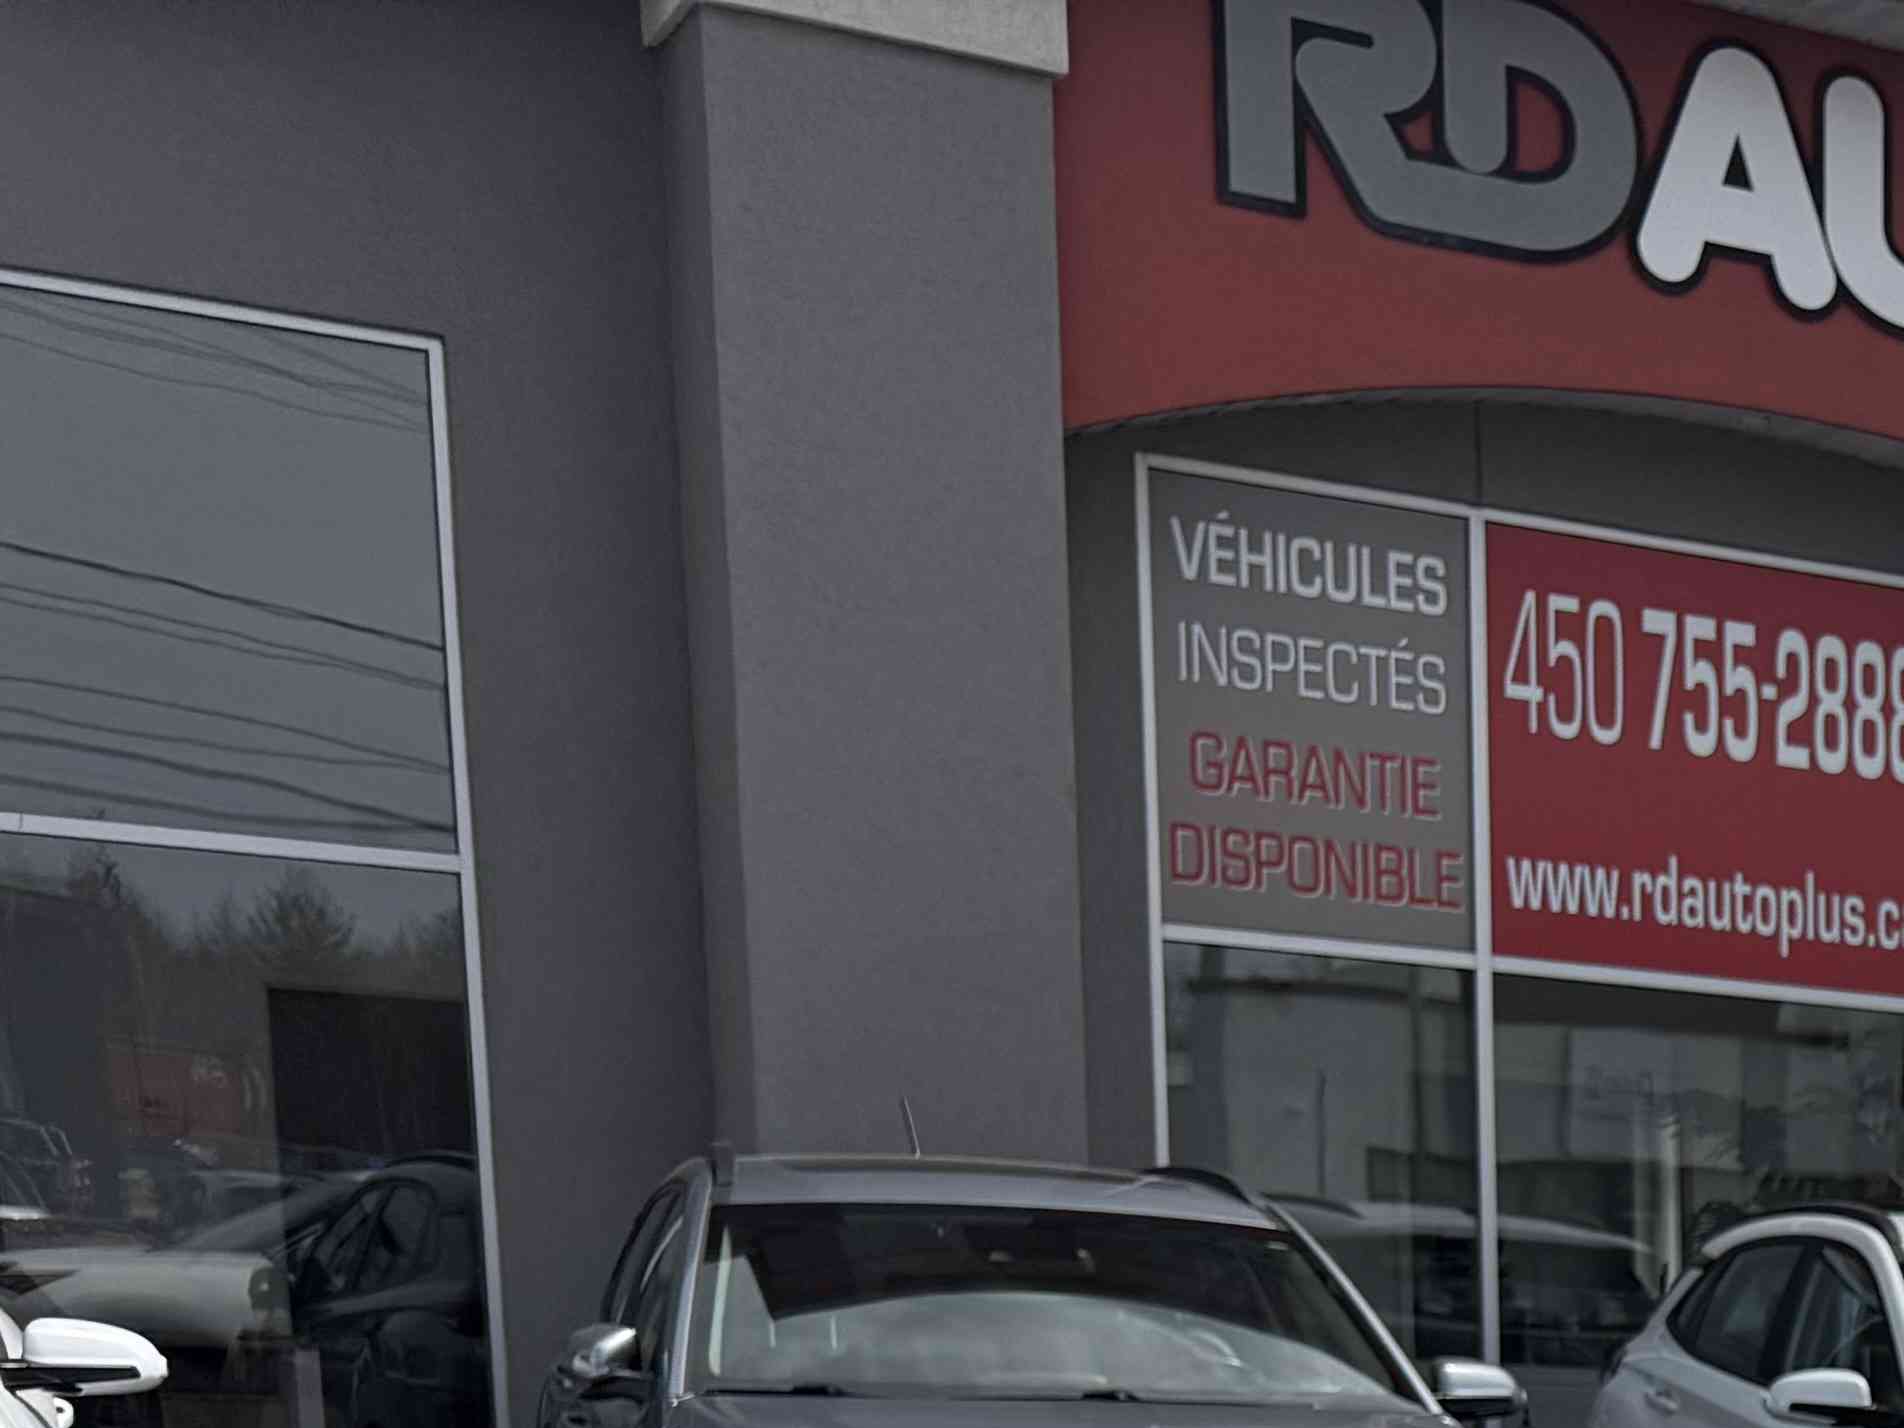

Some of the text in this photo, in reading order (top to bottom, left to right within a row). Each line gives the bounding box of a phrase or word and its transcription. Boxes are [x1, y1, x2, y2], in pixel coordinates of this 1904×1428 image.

[1168, 510, 1448, 617] VÉHICULES
[1177, 621, 1447, 715] INSPECTÉS
[1504, 589, 1624, 745] 450
[1188, 730, 1442, 821] GARANTIE
[1169, 820, 1466, 914] DISPONIBLE
